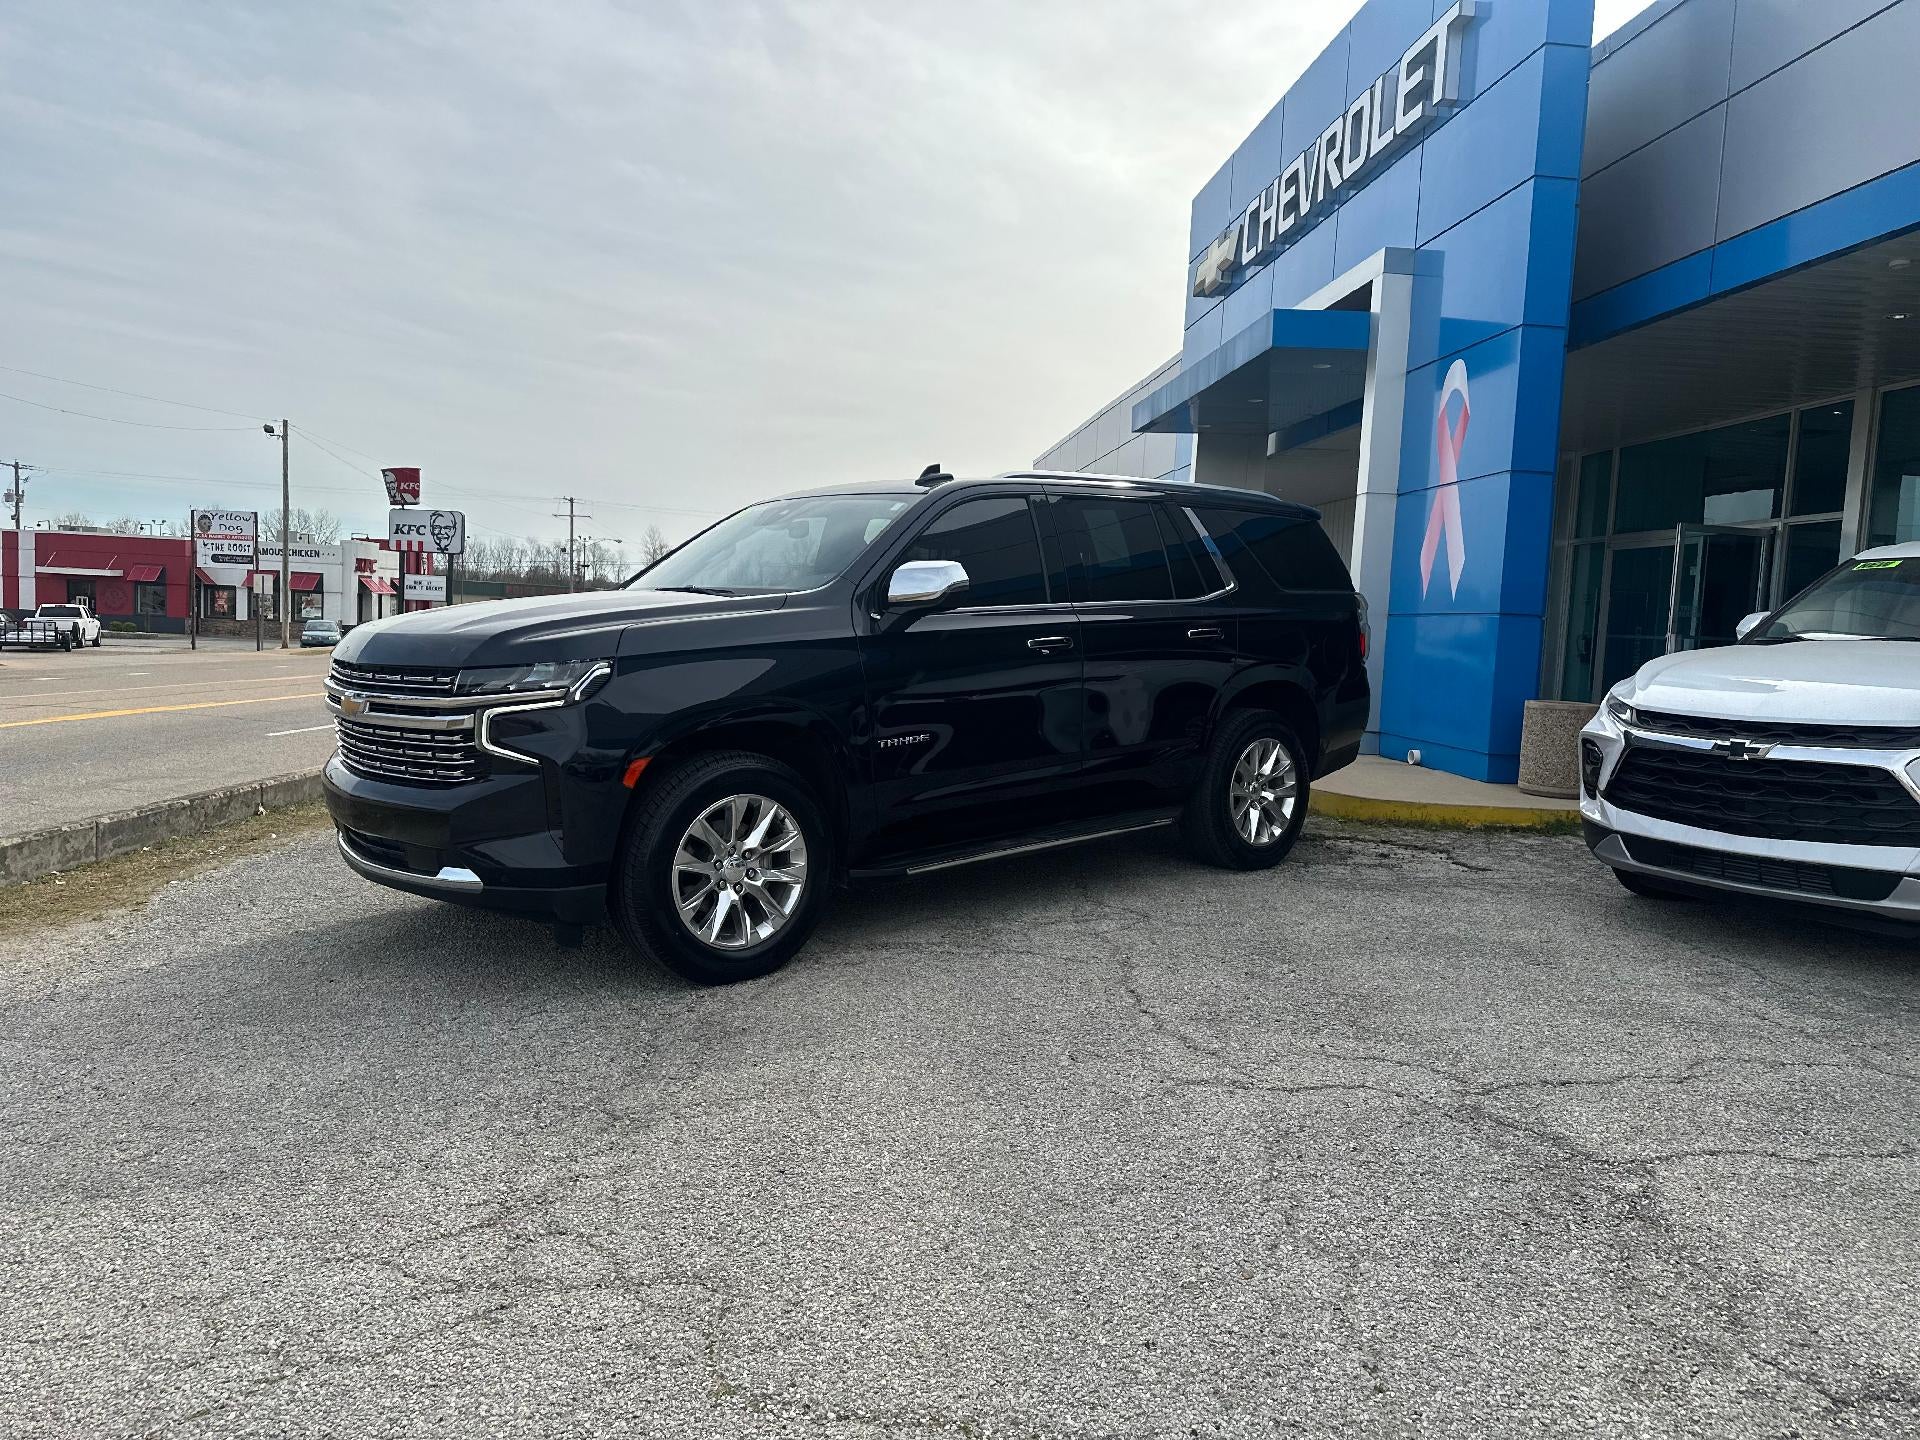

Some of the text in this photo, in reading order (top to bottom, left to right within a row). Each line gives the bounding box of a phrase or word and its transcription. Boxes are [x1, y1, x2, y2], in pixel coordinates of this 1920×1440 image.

[1242, 1, 1464, 266] CHEVROLET
[400, 482, 420, 490] KFC
[210, 512, 252, 522] Yellow
[219, 523, 244, 534] Dog
[394, 523, 426, 536] KFC
[211, 543, 251, 553] THE ROOST
[878, 733, 930, 748] TAHOE
